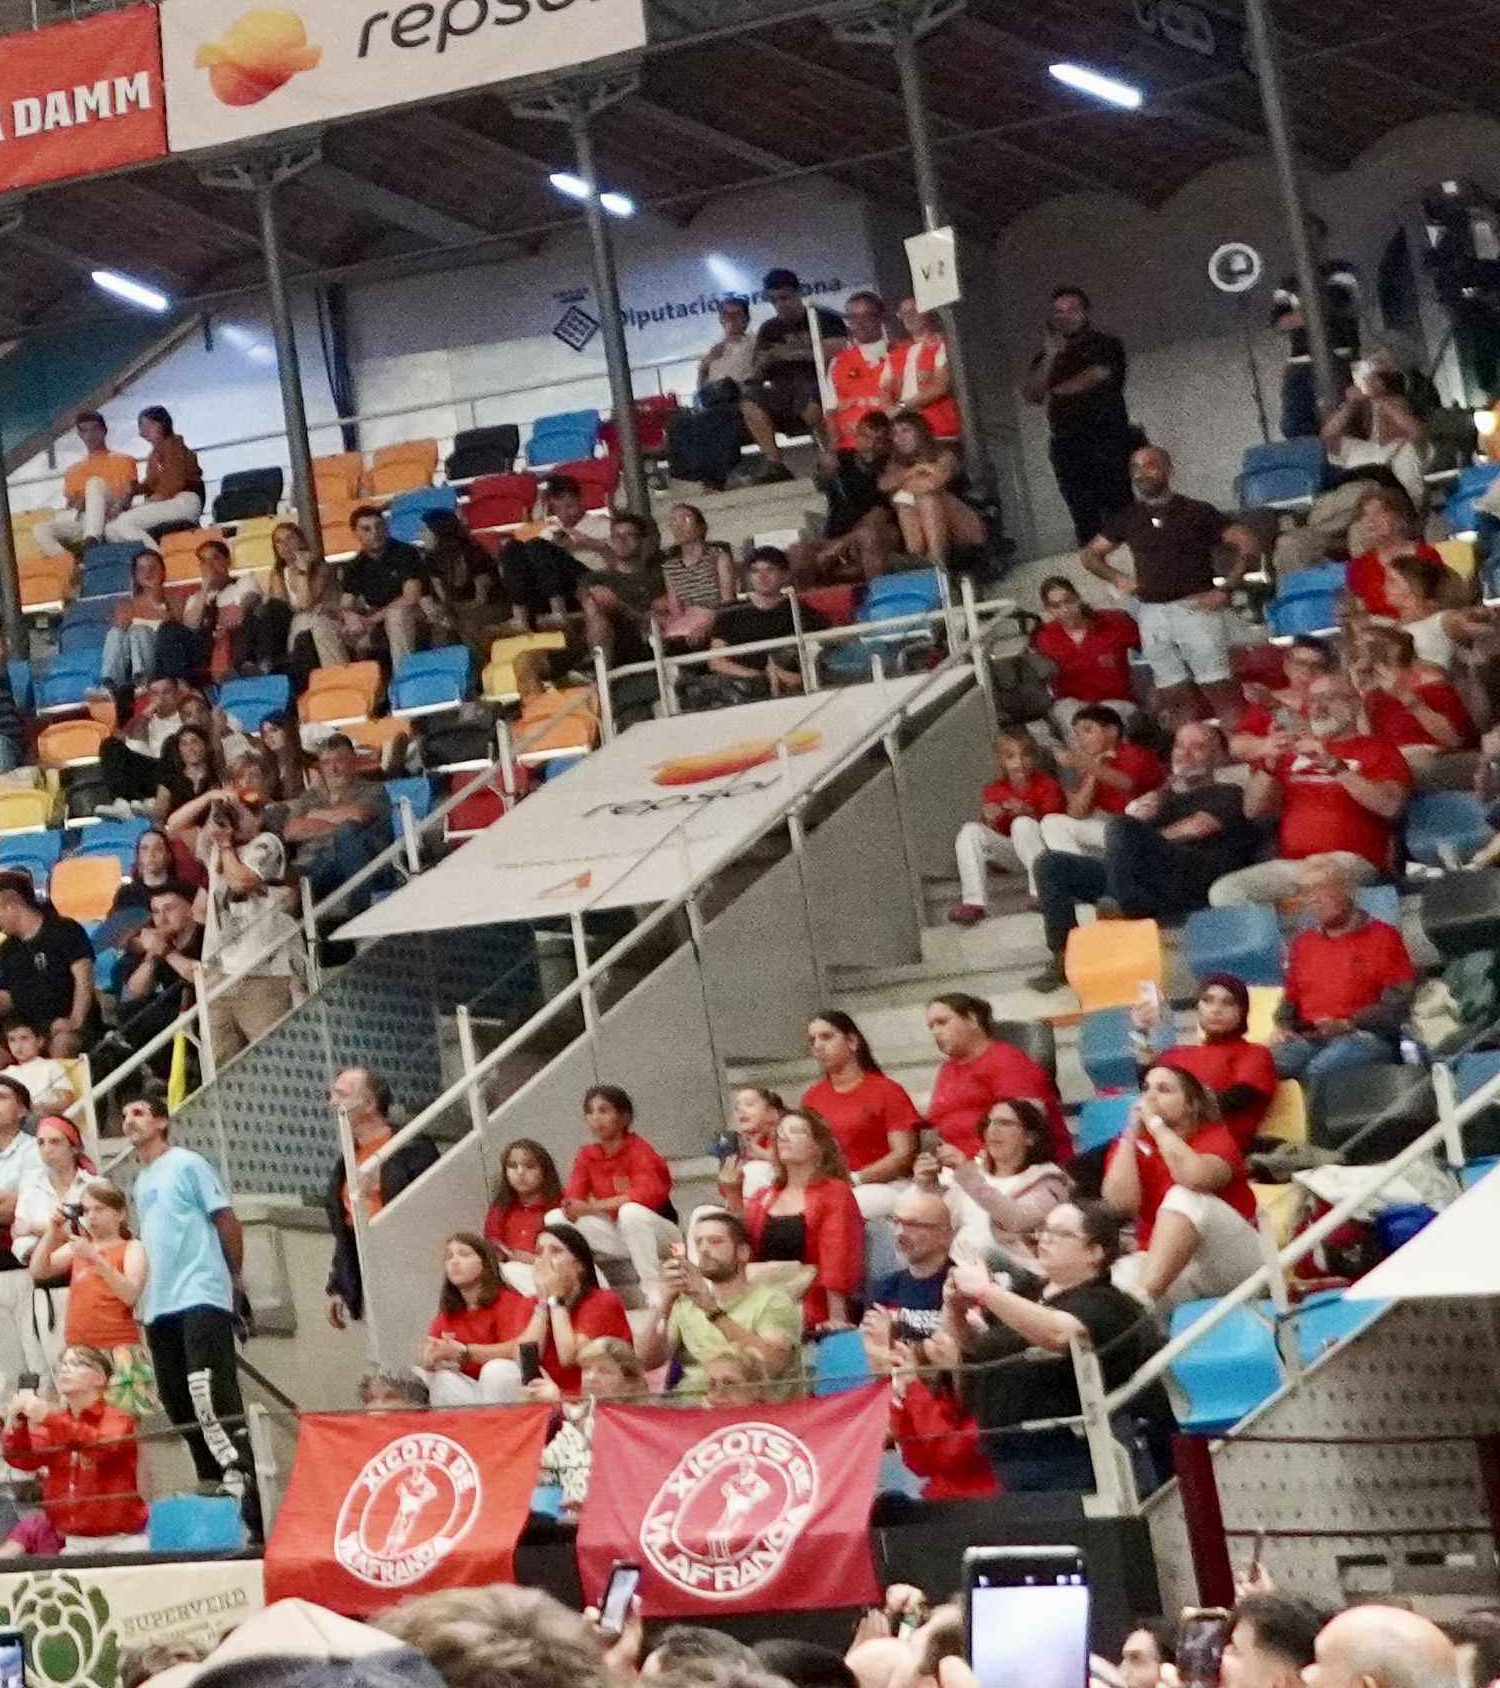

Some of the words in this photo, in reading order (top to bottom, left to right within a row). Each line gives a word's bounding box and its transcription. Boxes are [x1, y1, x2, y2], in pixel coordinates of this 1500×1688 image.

[13, 71, 152, 137] DAMM
[362, 1439, 449, 1494] XICOTS
[450, 1456, 476, 1494] DE
[666, 1430, 793, 1501] XICOTS
